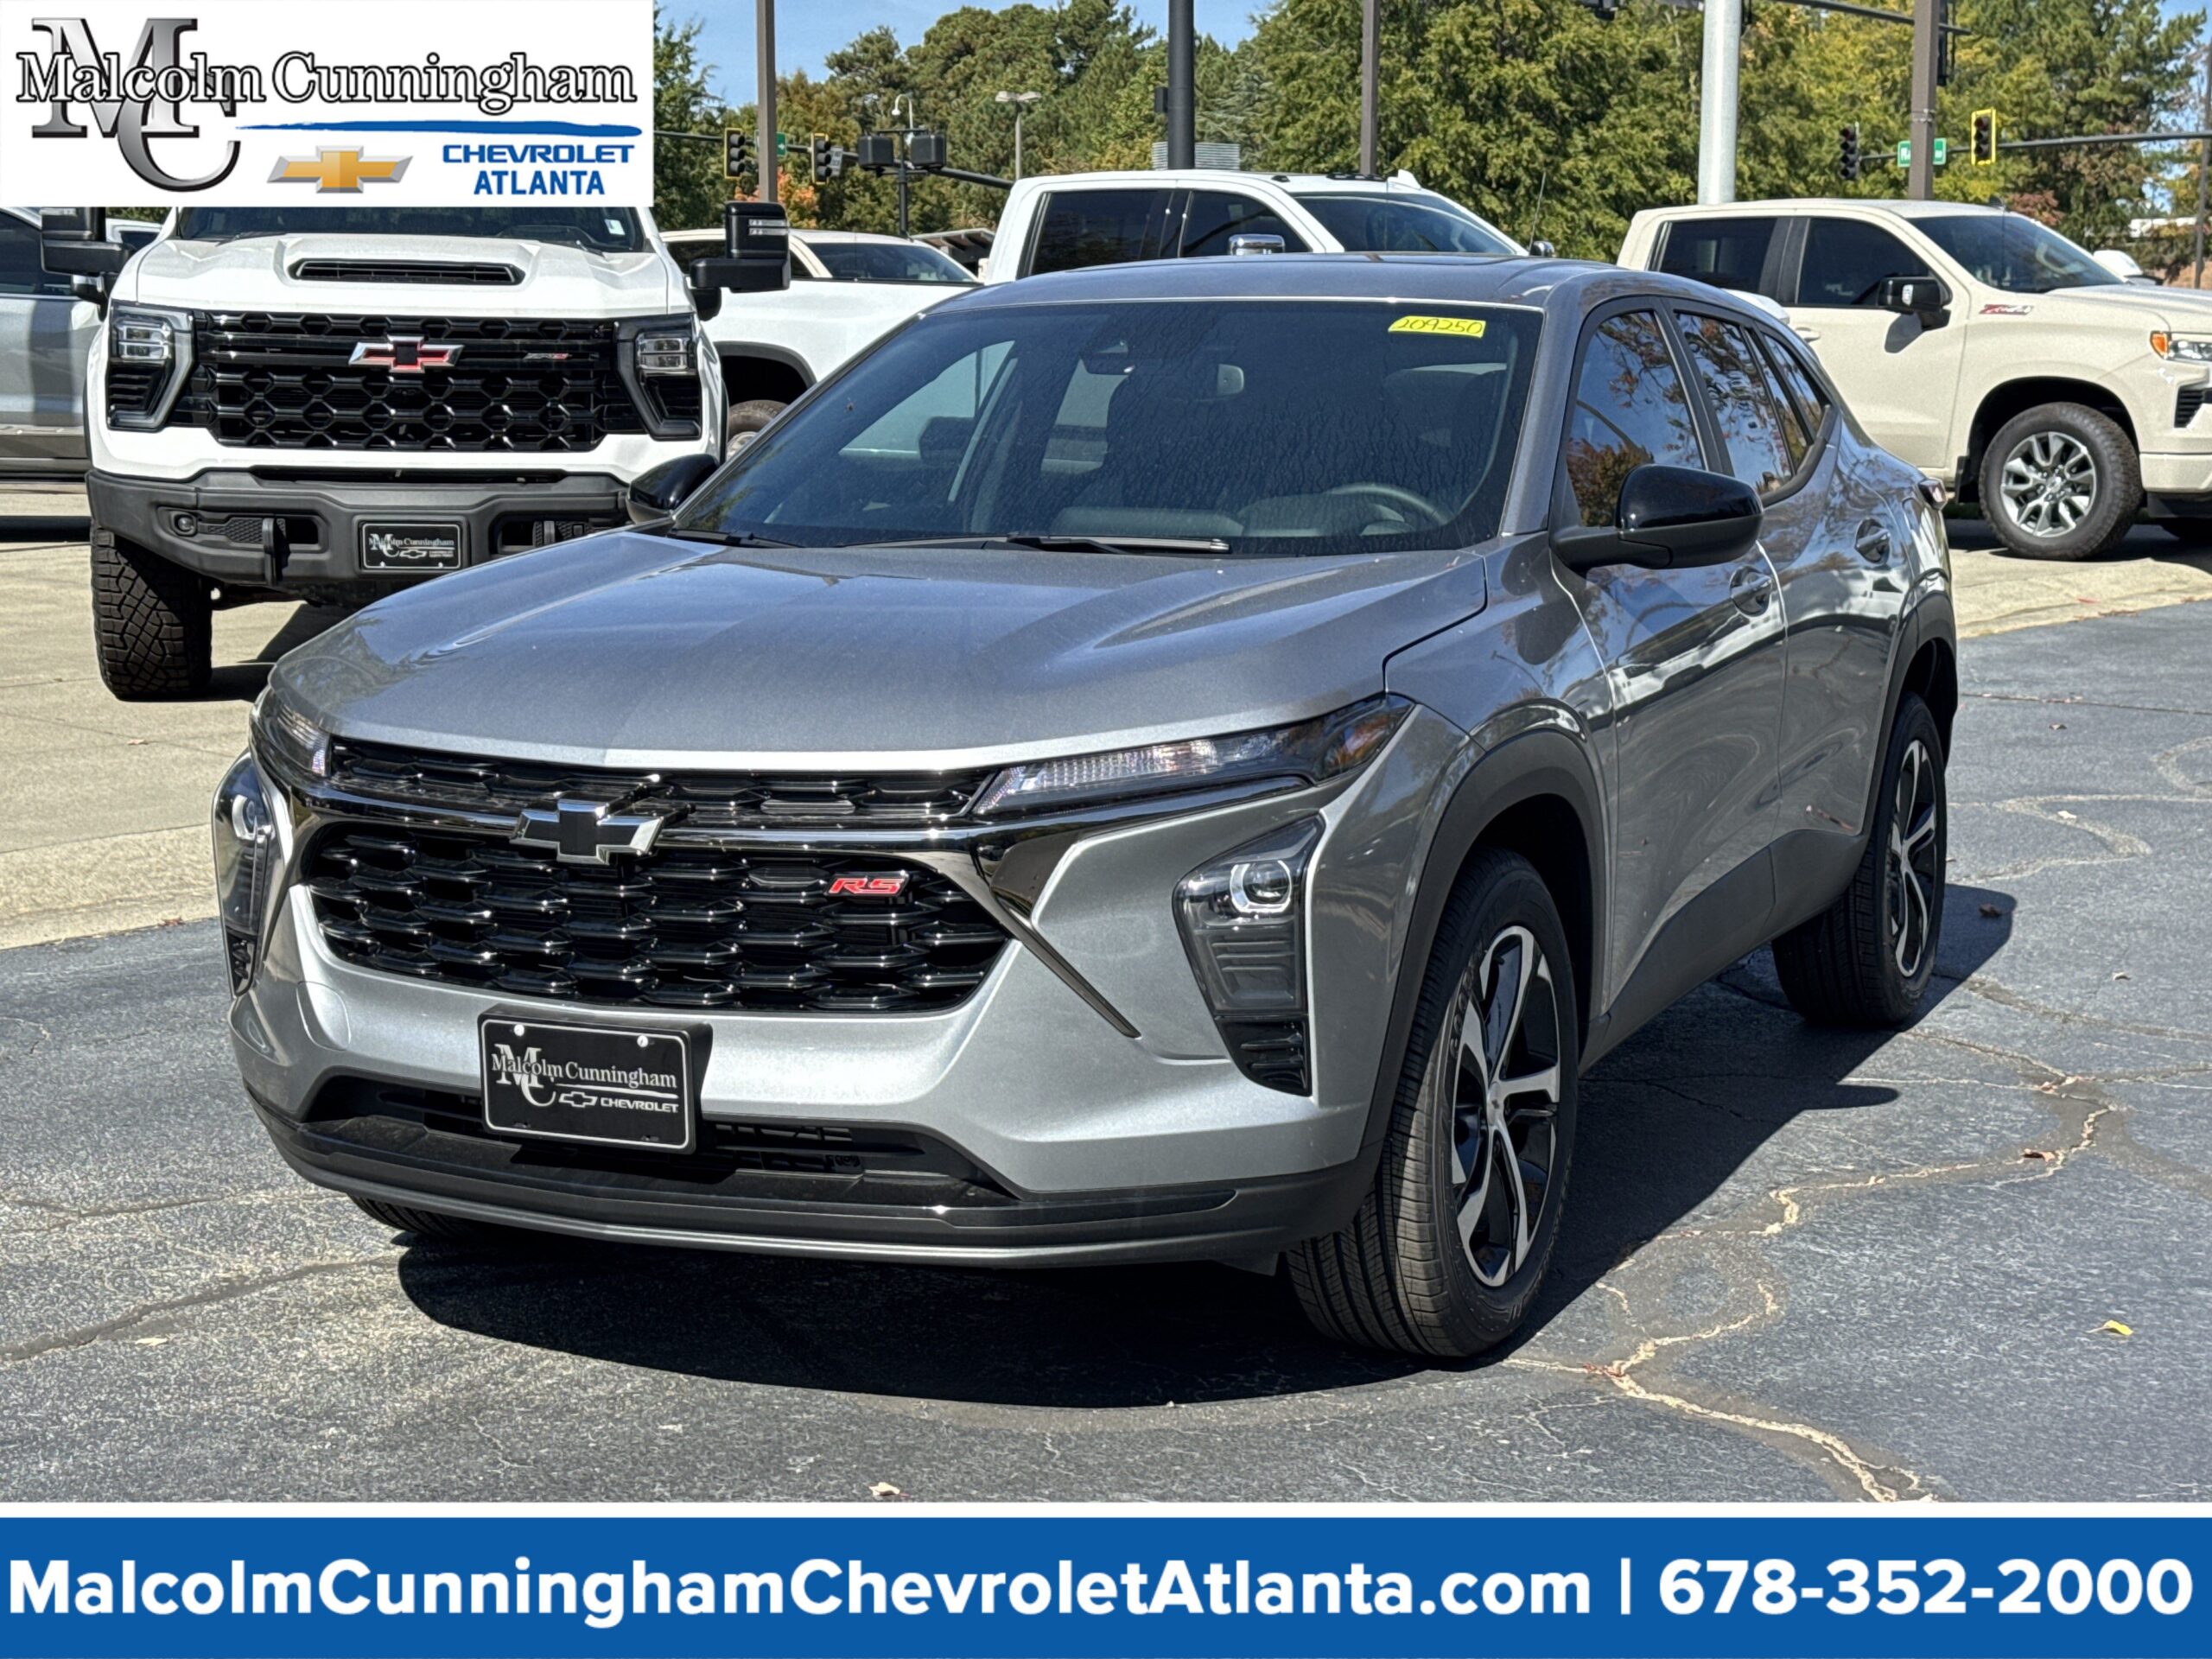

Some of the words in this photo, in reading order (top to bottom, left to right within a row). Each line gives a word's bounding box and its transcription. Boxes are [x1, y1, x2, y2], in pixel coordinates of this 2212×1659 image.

[1392, 317, 1484, 334] 209250
[829, 878, 906, 894] RS
[491, 1053, 563, 1078] Malcolm
[565, 1061, 677, 1089] Cunningham
[601, 1096, 679, 1113] CHEVROLET
